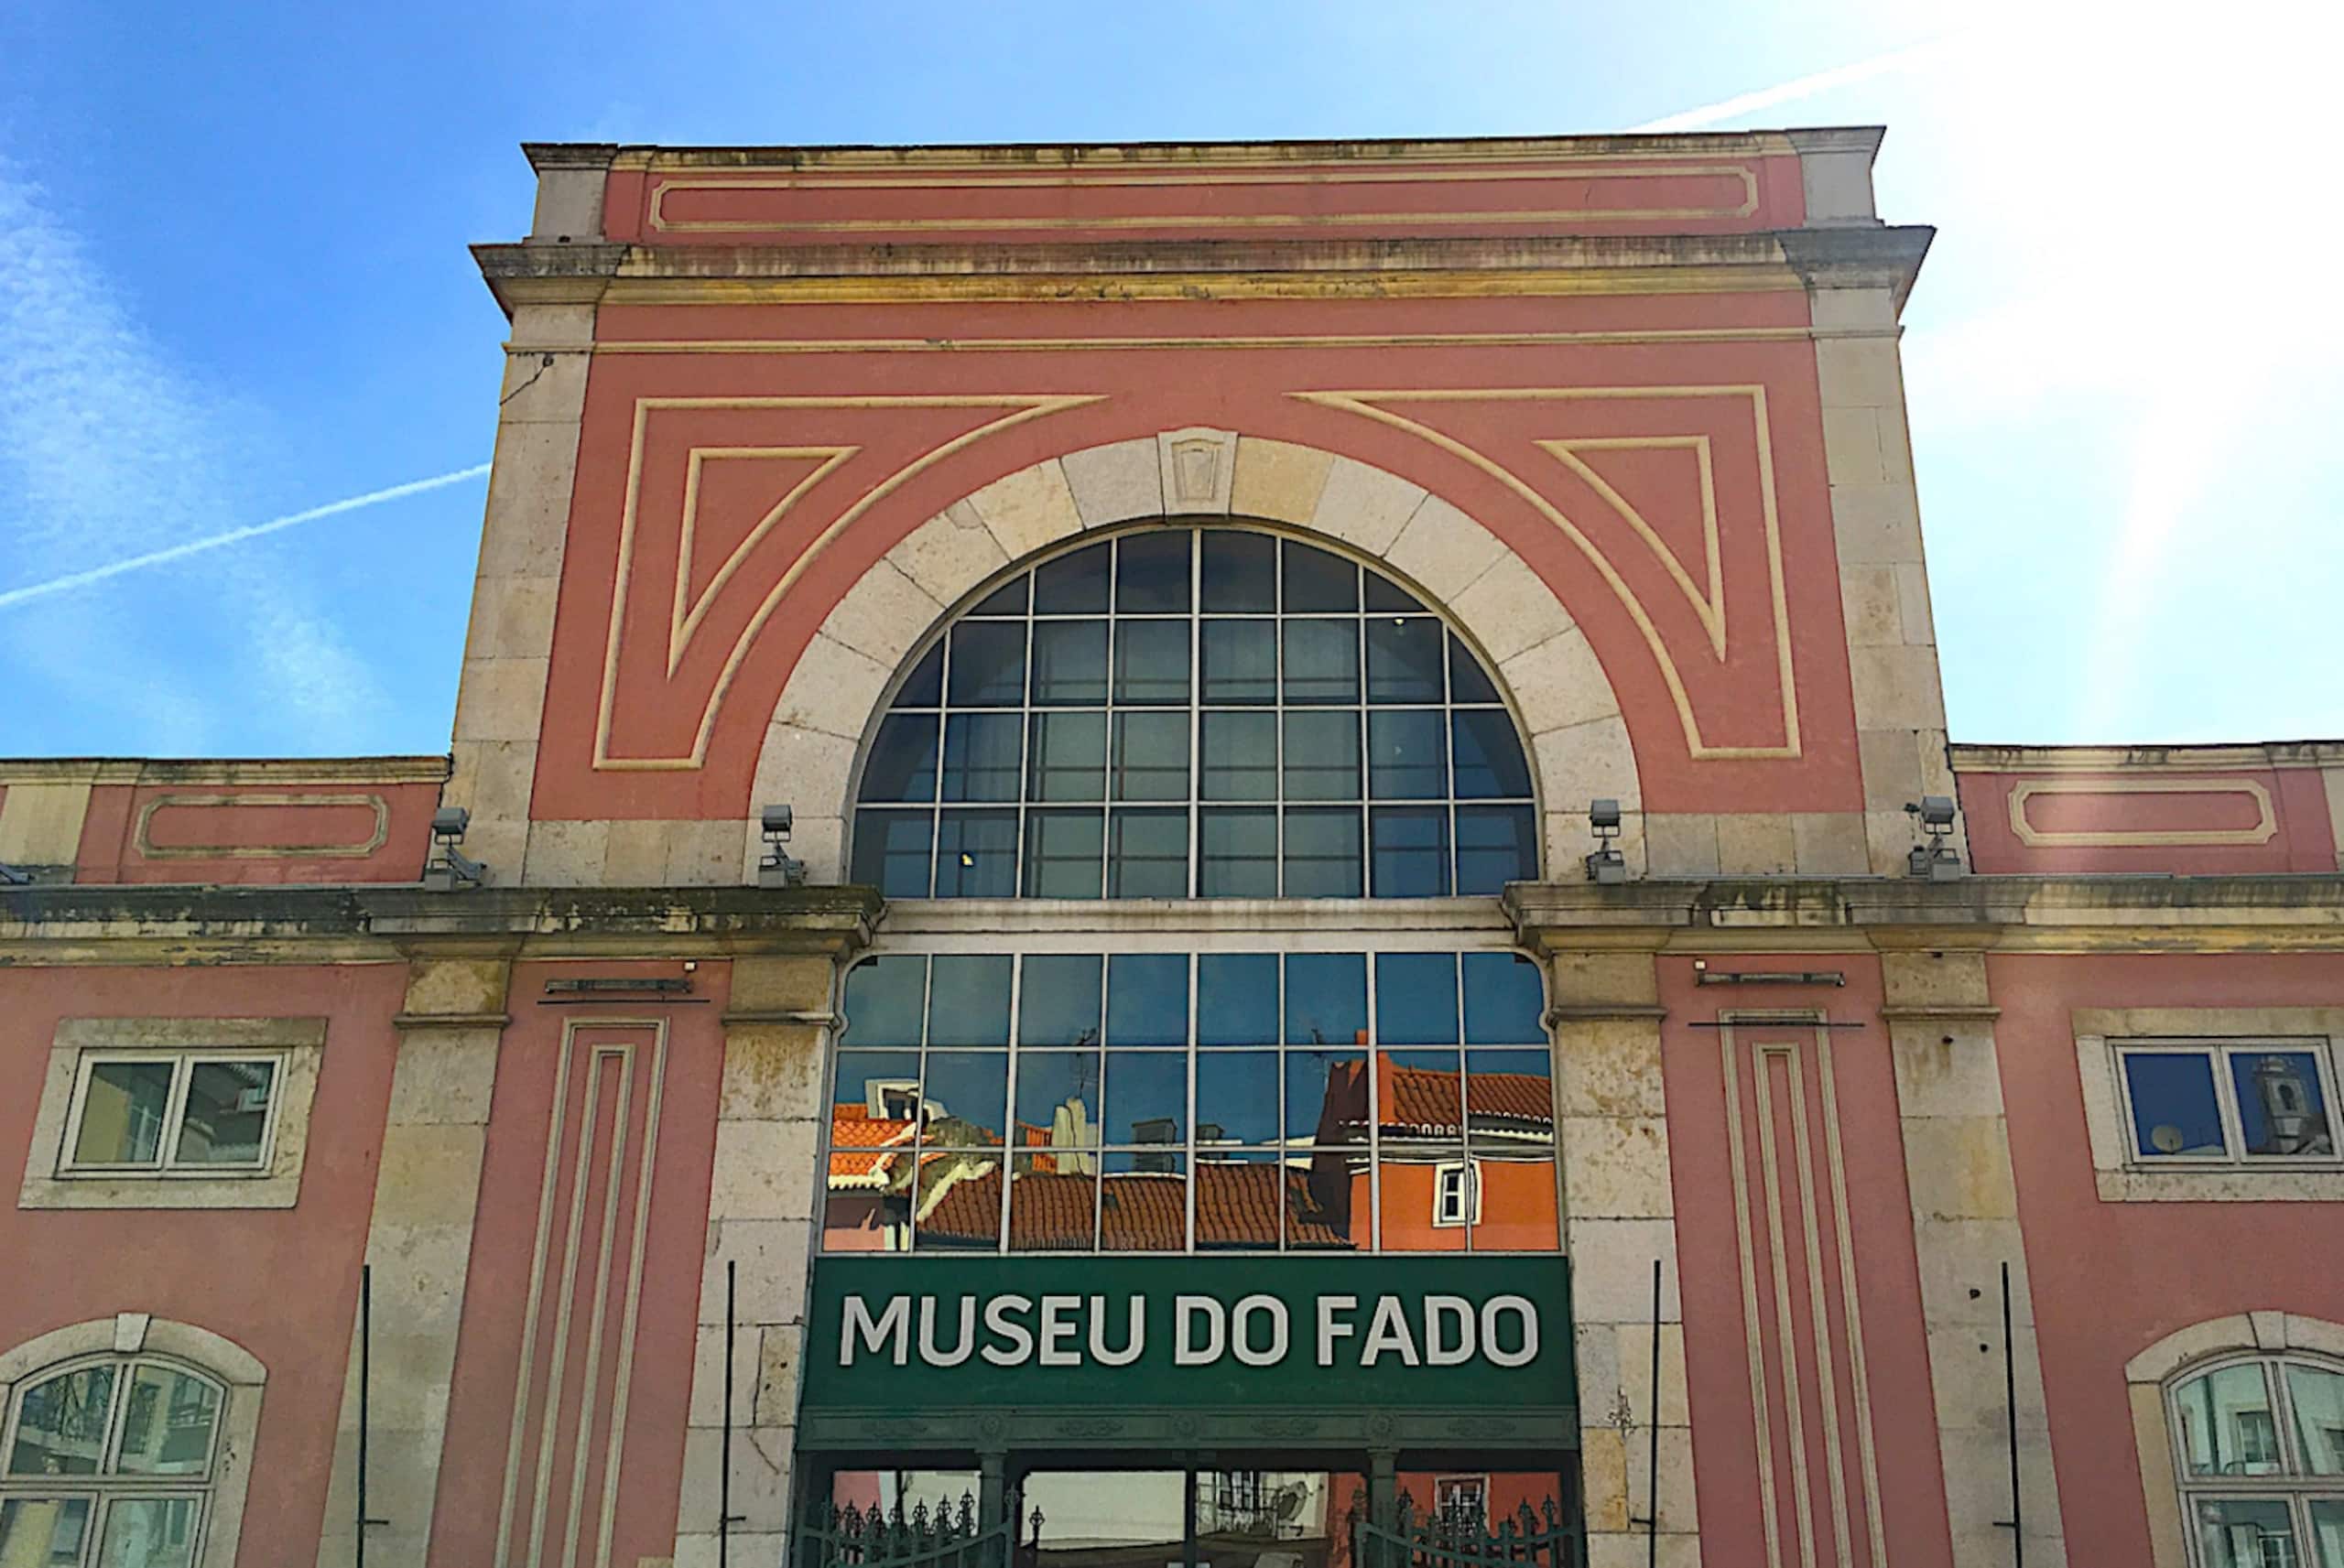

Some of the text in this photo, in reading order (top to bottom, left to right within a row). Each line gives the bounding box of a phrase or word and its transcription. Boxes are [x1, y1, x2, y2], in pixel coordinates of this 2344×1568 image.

[840, 1294, 1539, 1366] MUSEU DO FADO
